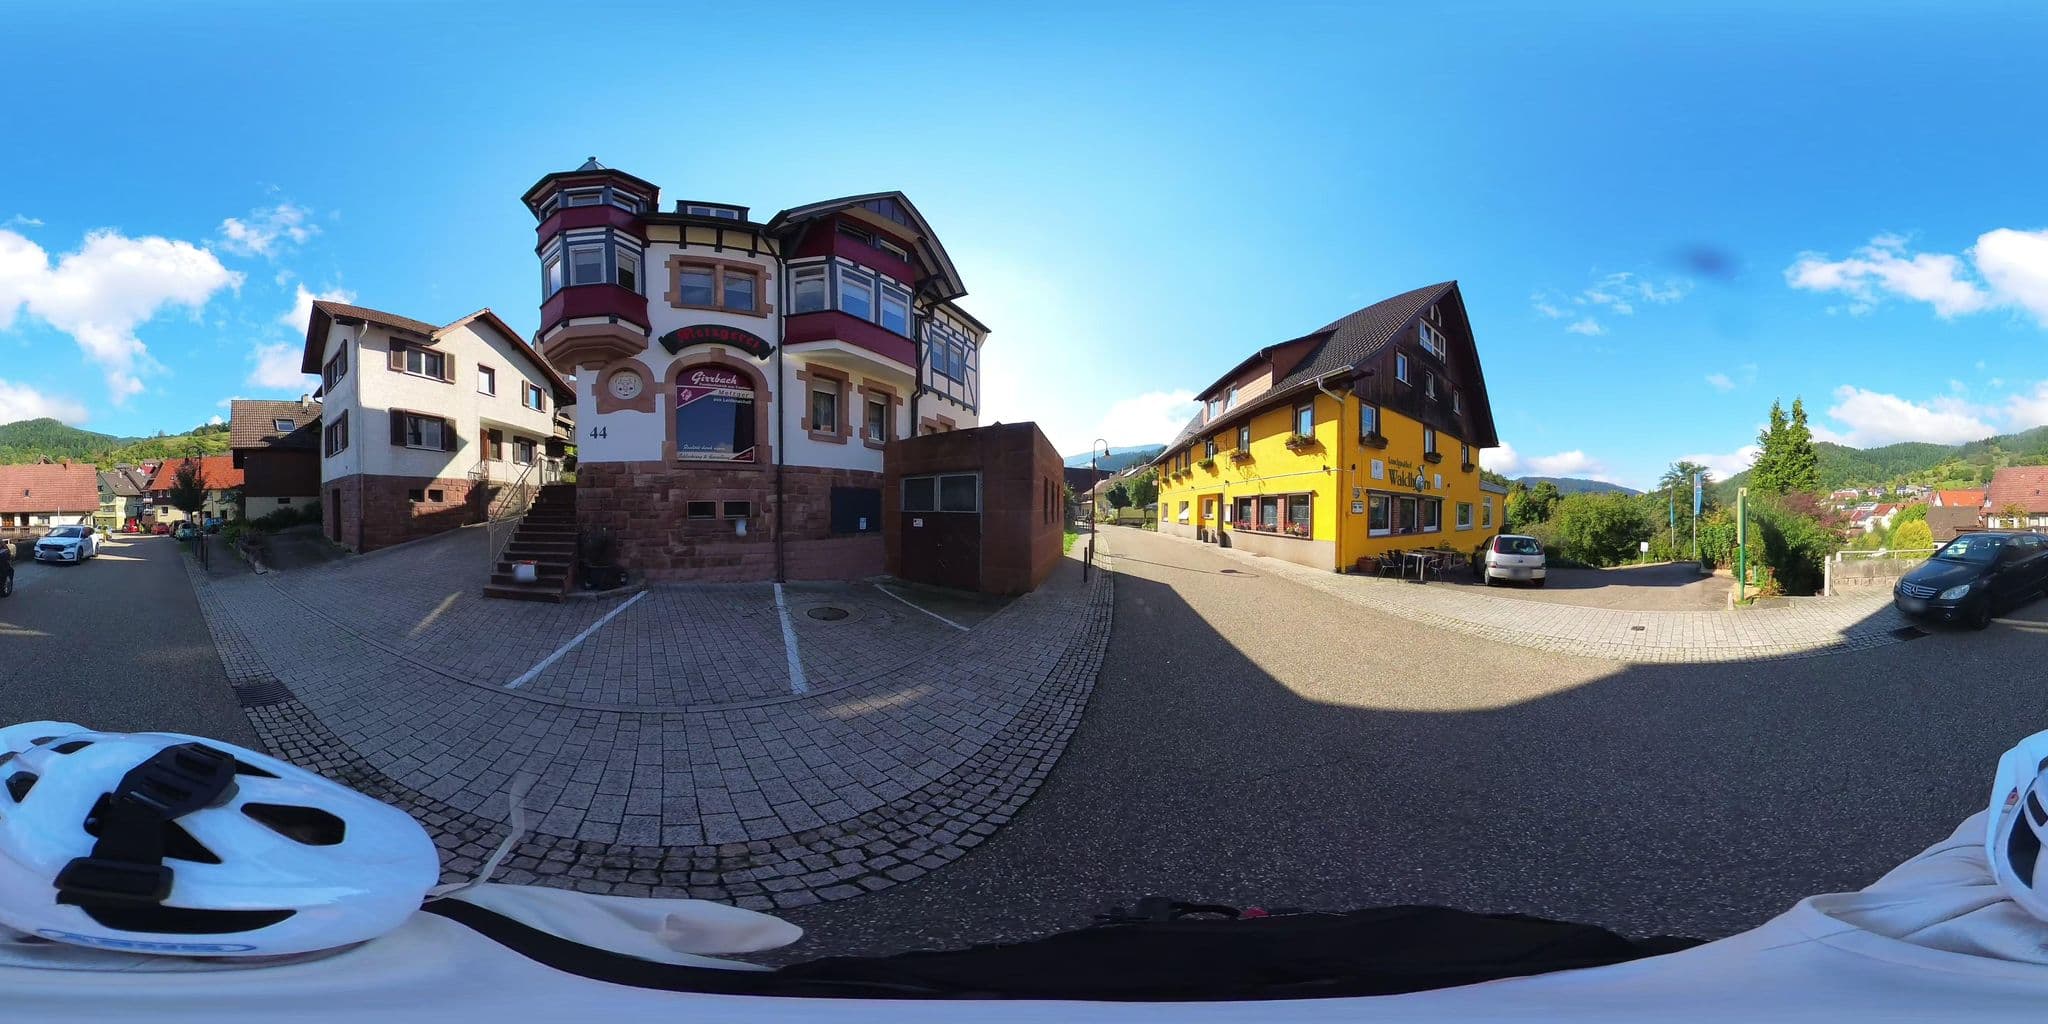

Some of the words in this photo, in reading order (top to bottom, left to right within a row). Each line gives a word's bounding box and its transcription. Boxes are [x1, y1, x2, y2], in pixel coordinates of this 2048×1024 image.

[691, 371, 737, 384] Girrbach
[589, 426, 607, 439] 44
[1389, 467, 1430, 491] Waldhorn
